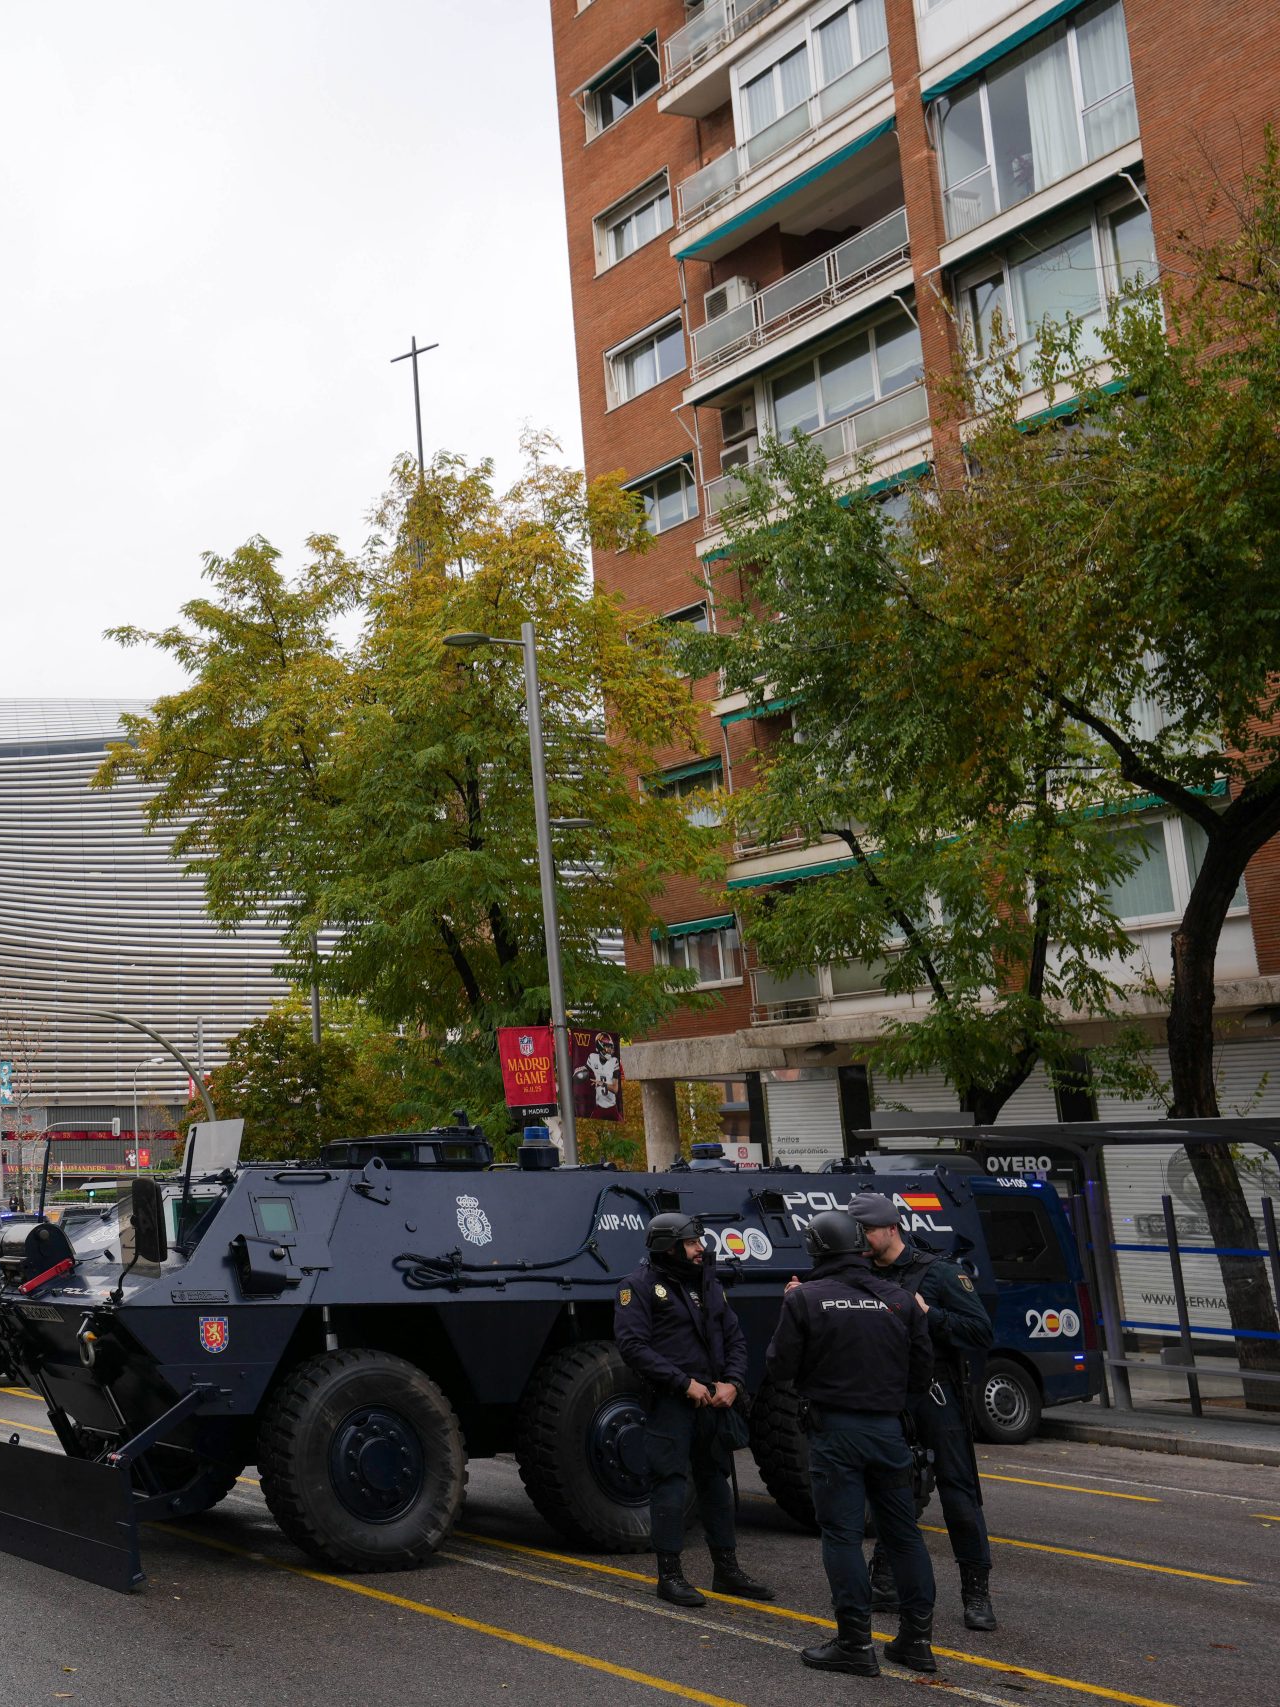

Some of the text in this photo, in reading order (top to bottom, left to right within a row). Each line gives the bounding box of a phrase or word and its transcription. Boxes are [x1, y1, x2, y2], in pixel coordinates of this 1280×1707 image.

[508, 1056, 550, 1072] MADRID
[515, 1070, 548, 1085] GAME
[996, 1177, 1028, 1188] 1U-109
[782, 1191, 913, 1211] POLA
[594, 1213, 645, 1231] UIP-101
[791, 1213, 954, 1232] NNAL
[1025, 1308, 1081, 1339] 200
